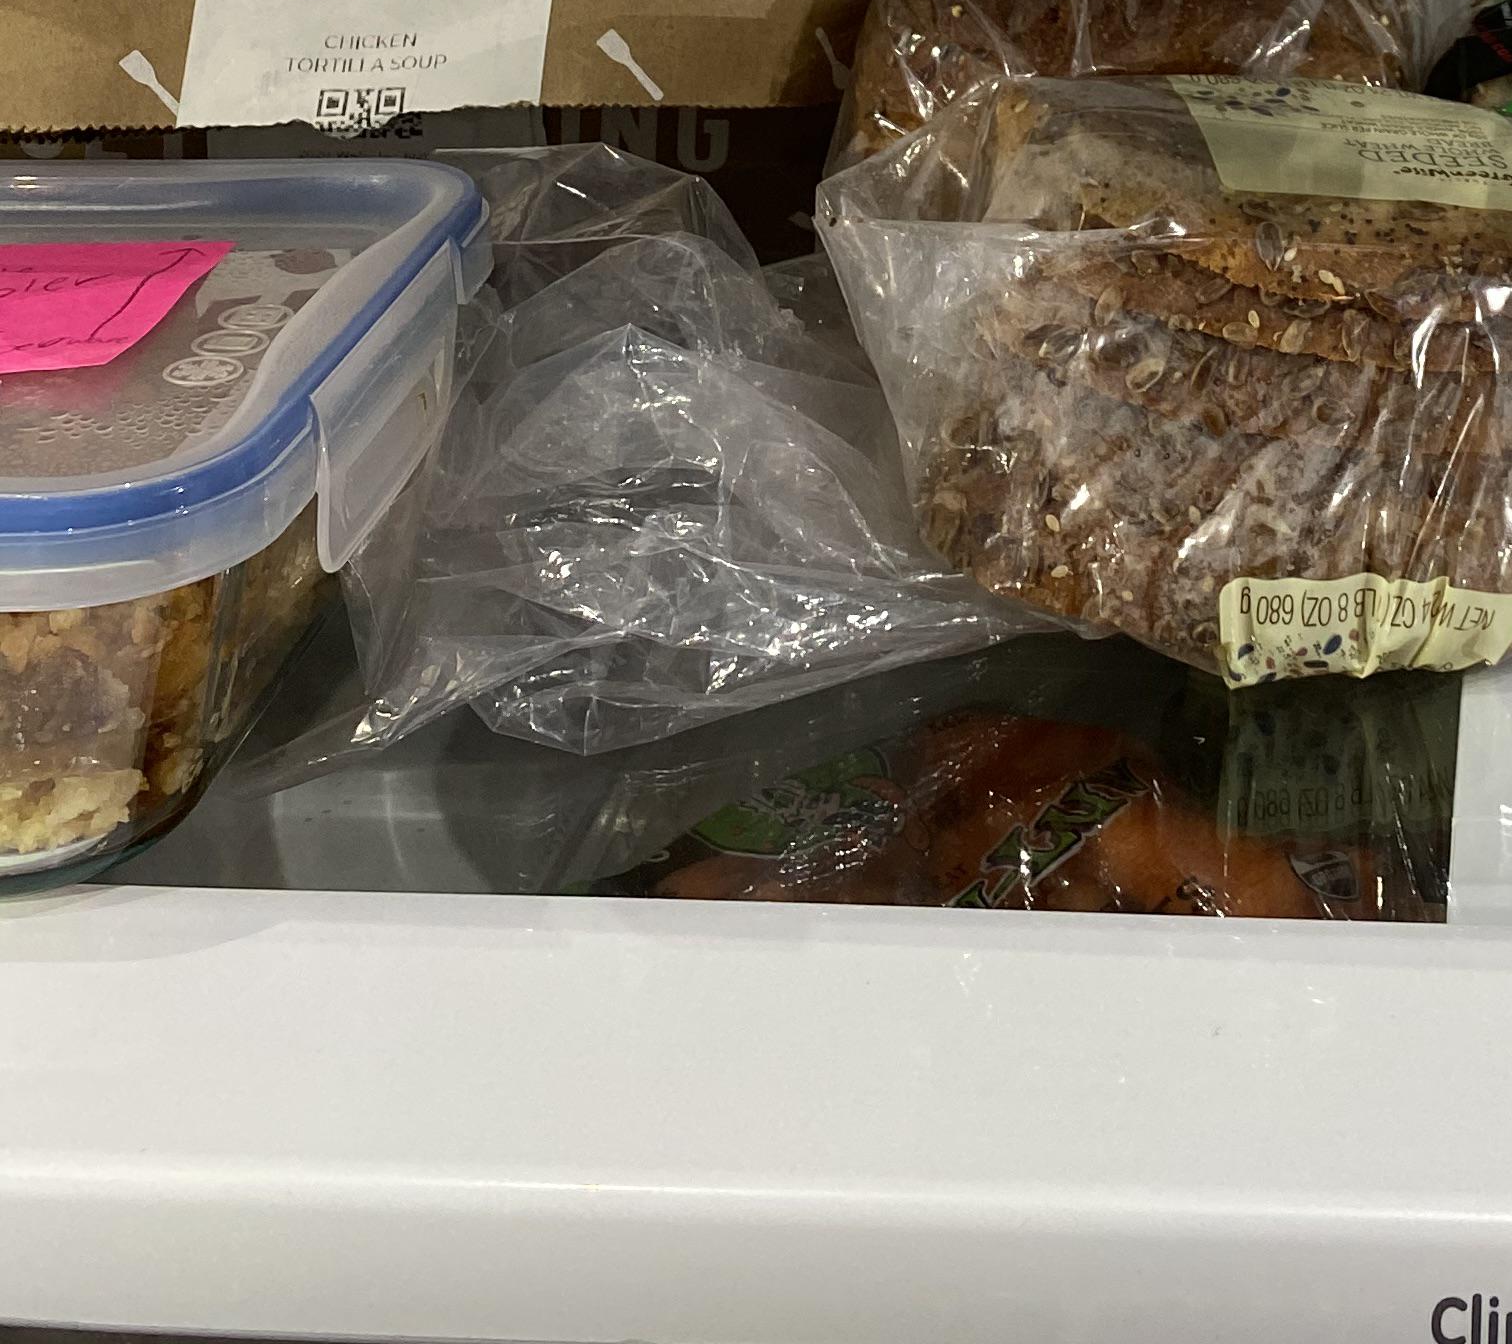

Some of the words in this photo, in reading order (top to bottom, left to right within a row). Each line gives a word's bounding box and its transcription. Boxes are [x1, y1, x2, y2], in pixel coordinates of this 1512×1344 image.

[324, 32, 417, 50] CHICKEN
[285, 56, 385, 73] TORTILLA
[389, 54, 448, 72] SOUP
[1343, 138, 1421, 151] WHEAT
[1357, 149, 1508, 170] SEEDED
[1239, 586, 1252, 615] g
[1255, 594, 1295, 627] 680
[1300, 589, 1333, 628] OZ)
[1338, 593, 1349, 622] 8
[1354, 587, 1377, 618] LB
[1390, 595, 1416, 629] OZ
[1454, 606, 1496, 631] NET
